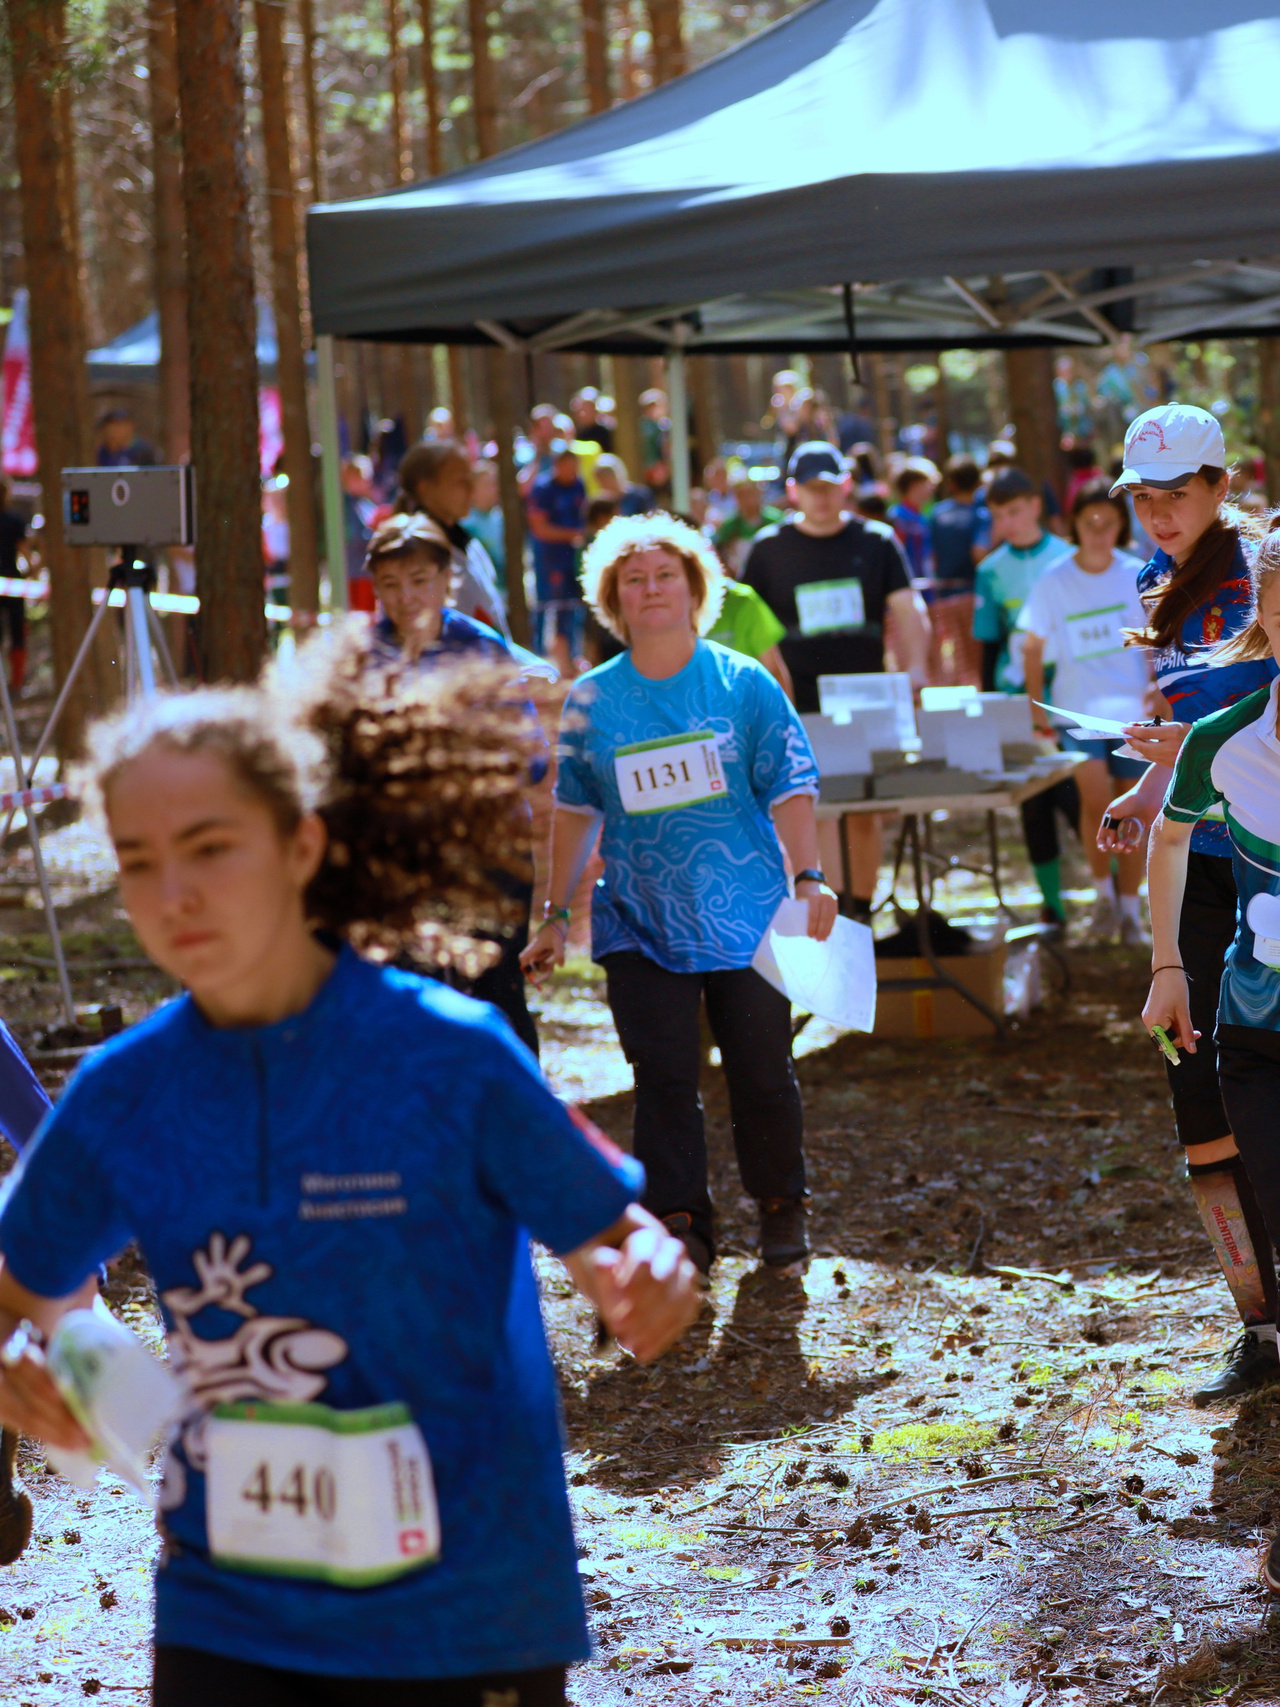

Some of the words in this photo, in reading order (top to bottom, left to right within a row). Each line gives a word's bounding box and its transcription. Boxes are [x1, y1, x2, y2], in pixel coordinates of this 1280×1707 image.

[632, 760, 692, 793] 1131
[1212, 1205, 1243, 1267] ORIENTEERING
[241, 1460, 337, 1523] 440
